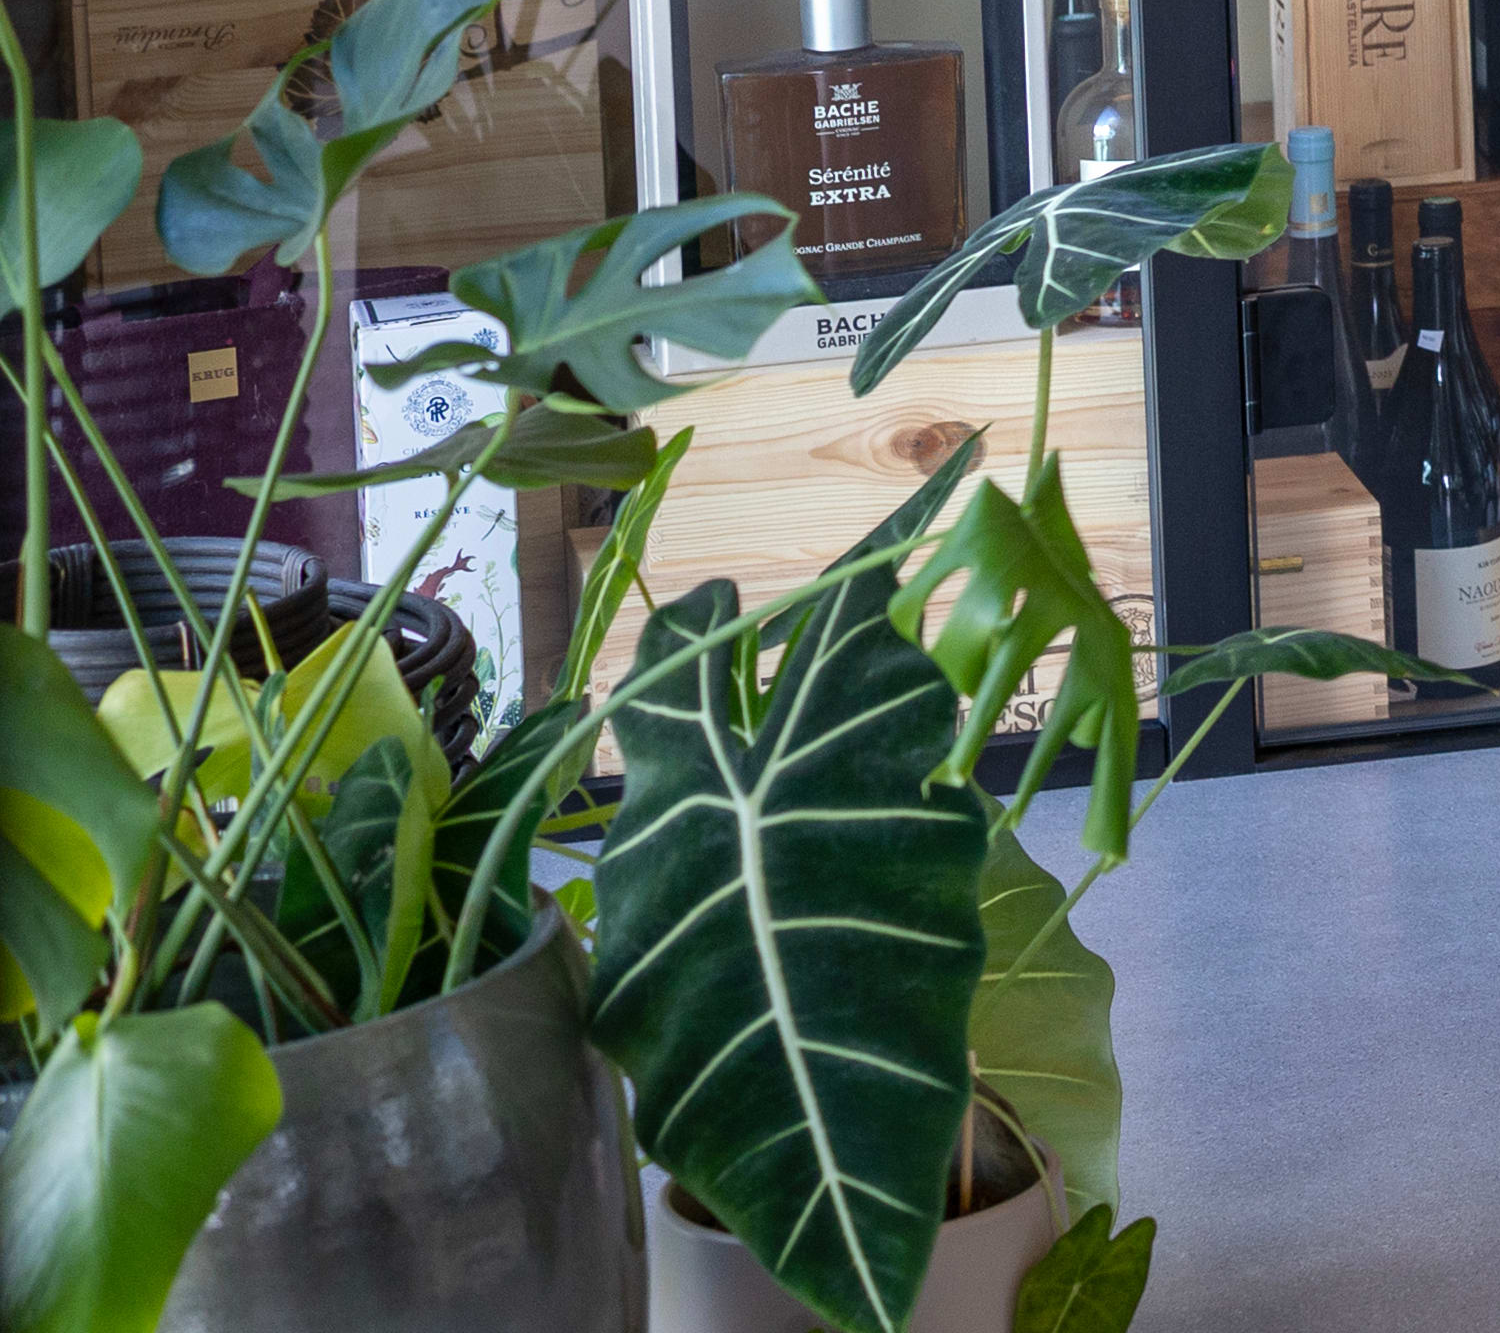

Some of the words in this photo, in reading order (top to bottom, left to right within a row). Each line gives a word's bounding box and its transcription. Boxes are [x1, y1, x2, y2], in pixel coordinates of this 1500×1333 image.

[813, 100, 880, 120] BACHE
[814, 114, 880, 130] GABRIELSEN
[808, 161, 892, 186] Sérénité
[809, 184, 892, 207] EXTRA
[191, 366, 236, 383] KRUG
